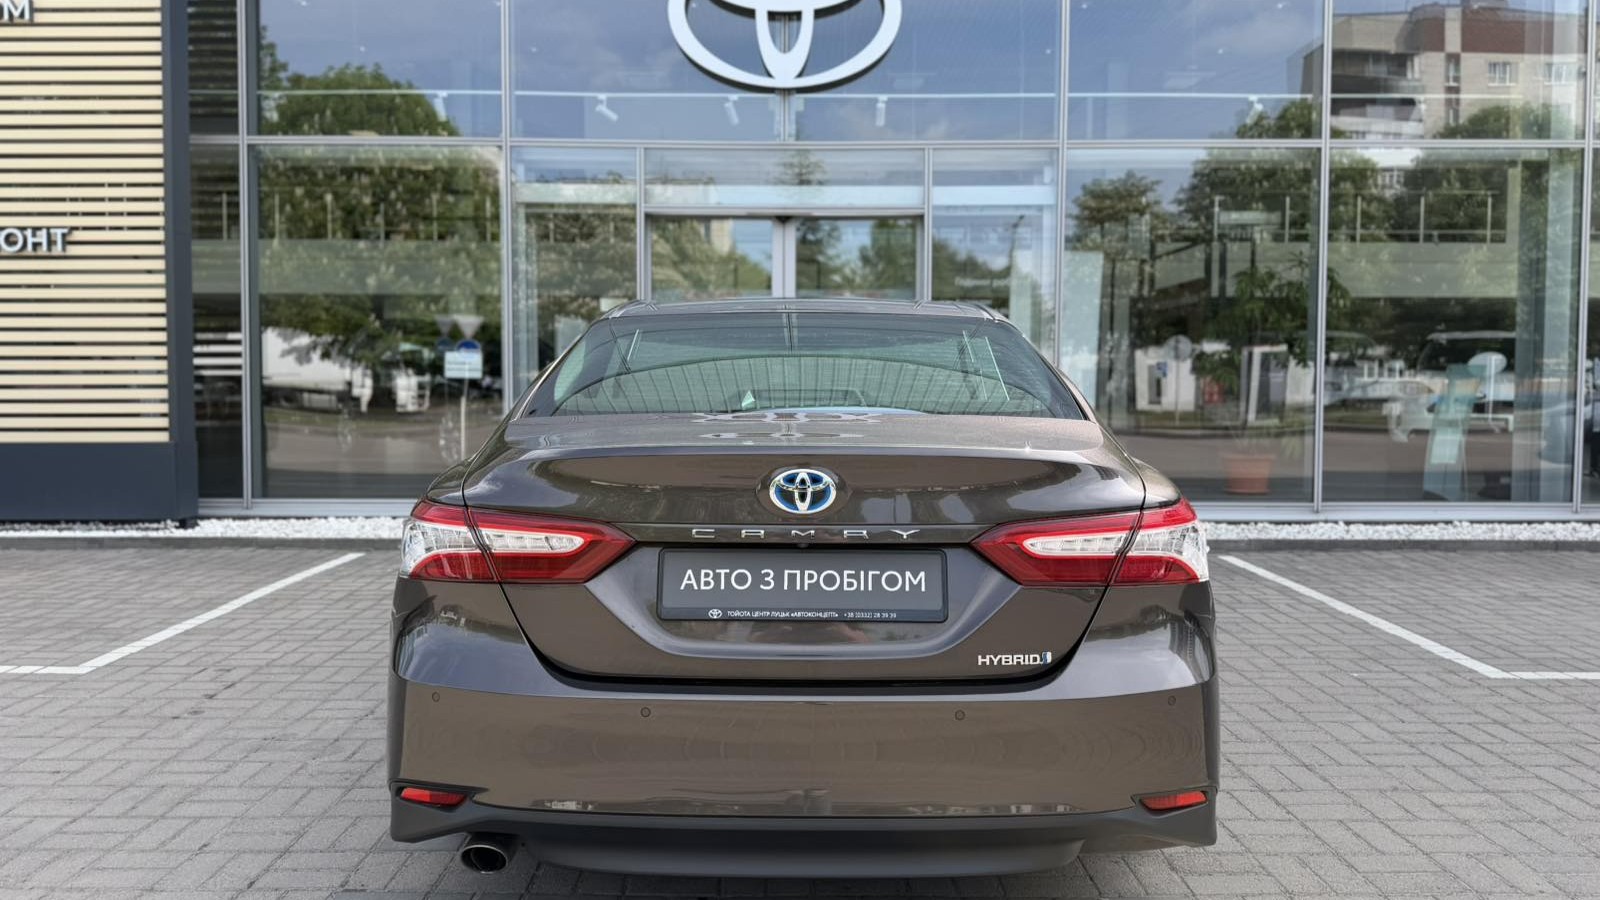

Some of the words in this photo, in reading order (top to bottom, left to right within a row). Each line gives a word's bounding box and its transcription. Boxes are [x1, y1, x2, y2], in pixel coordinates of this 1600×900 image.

[691, 528, 921, 540] CAMRY
[679, 568, 753, 591] АВТО
[782, 569, 928, 593] ПРОБІГОМ
[727, 609, 751, 617] ТОЙОТА
[751, 610, 770, 618] ЦЕНТР
[770, 610, 790, 618] ЛУЦЬК
[977, 653, 1041, 666] HYBRID
